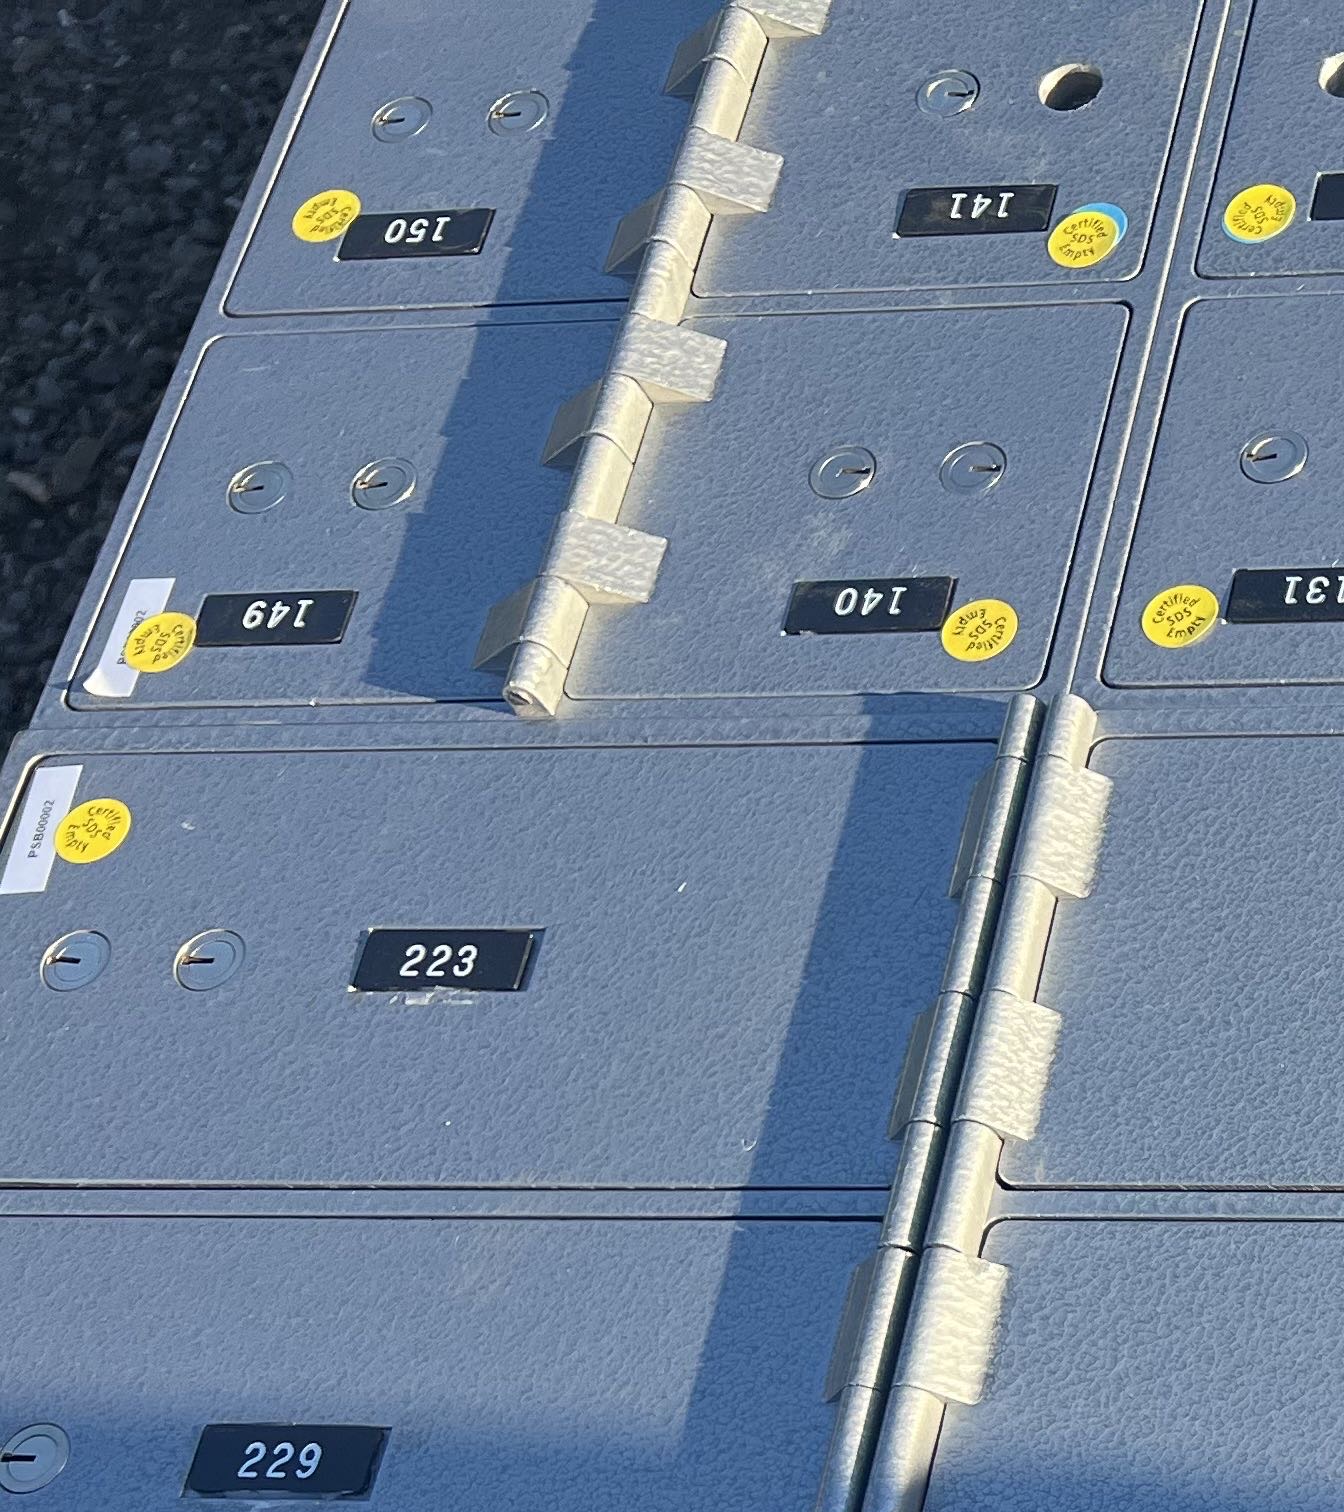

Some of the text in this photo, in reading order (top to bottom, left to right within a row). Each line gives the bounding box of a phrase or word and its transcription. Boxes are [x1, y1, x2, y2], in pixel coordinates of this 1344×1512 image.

[316, 208, 339, 224] SDS
[950, 192, 1015, 219] 141
[1251, 206, 1269, 225] SDS
[385, 217, 451, 243] 150
[1063, 218, 1108, 239] Certified
[1070, 233, 1094, 244] SDS
[1058, 243, 1095, 261] Empty
[242, 599, 314, 629] 149
[834, 587, 907, 616] 140
[1153, 593, 1201, 624] Certified
[952, 608, 987, 636] Empty
[969, 620, 993, 641] SDS
[1166, 608, 1192, 626] SDS
[1166, 615, 1206, 639] Empty
[965, 616, 1007, 651] Certified
[27, 800, 55, 858] PSB00002
[83, 818, 102, 839] SDS
[88, 806, 121, 841] Certified
[65, 824, 89, 853] Empty
[399, 944, 478, 977] 223
[237, 1442, 323, 1479] 229
